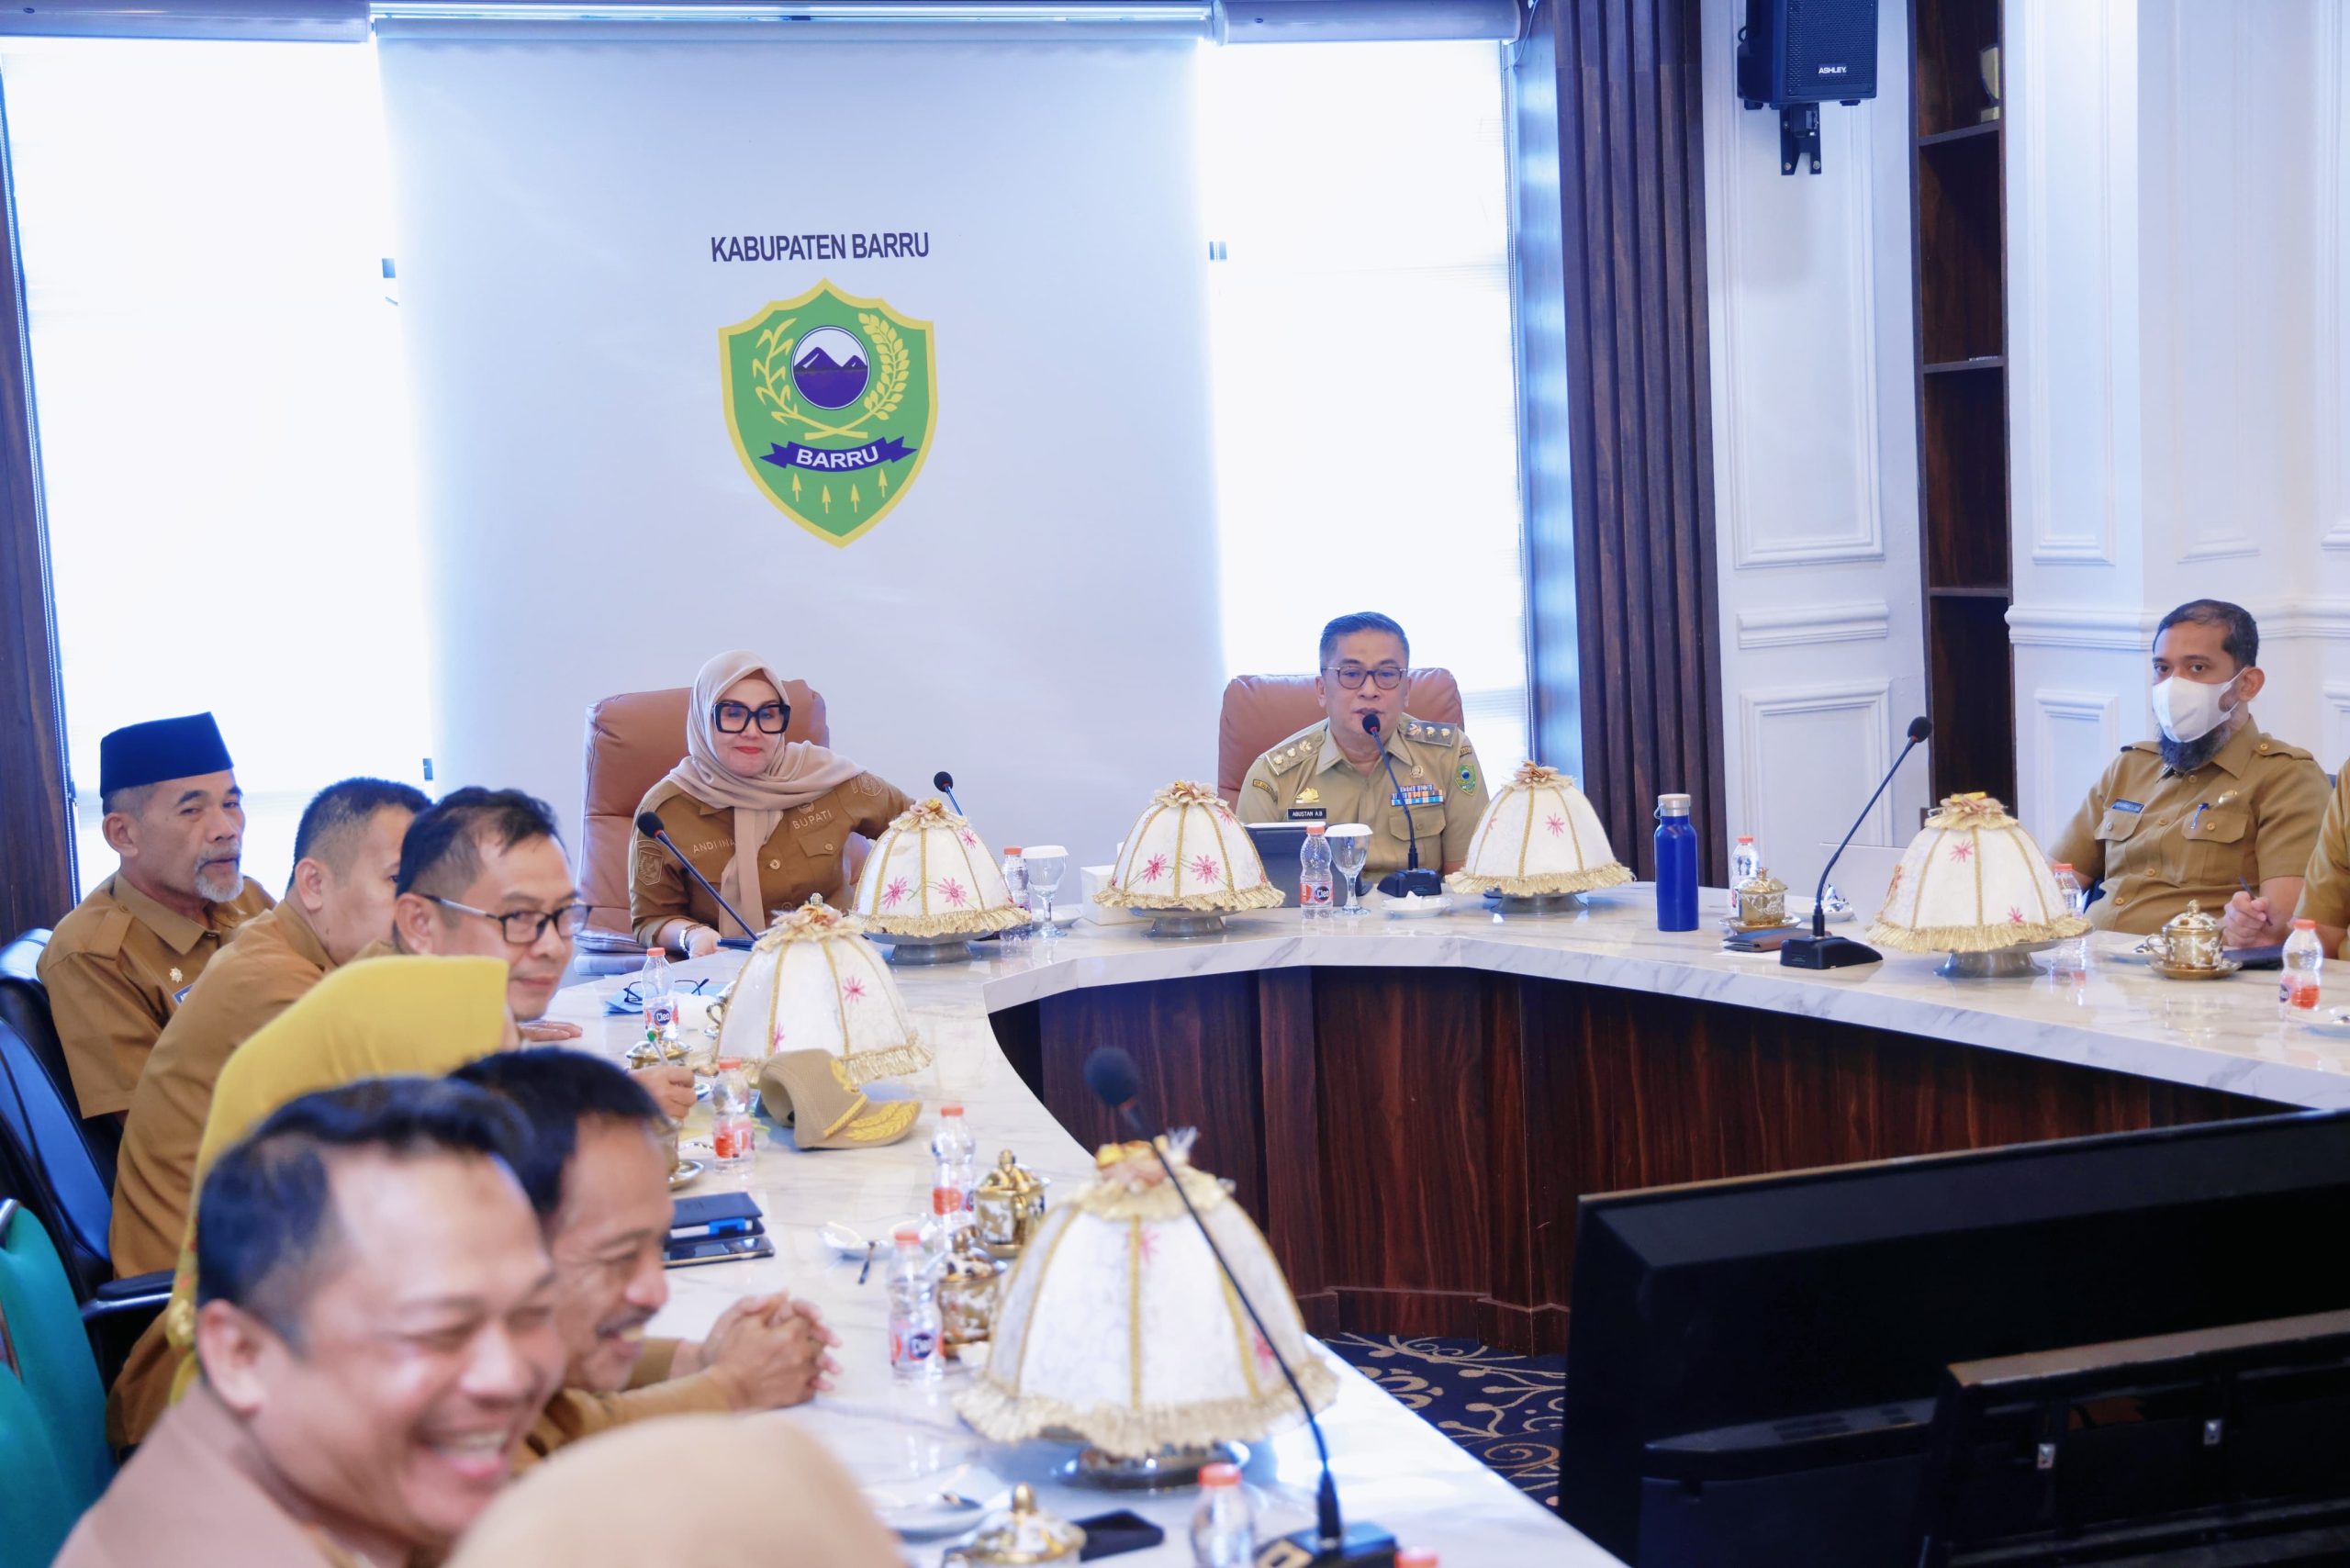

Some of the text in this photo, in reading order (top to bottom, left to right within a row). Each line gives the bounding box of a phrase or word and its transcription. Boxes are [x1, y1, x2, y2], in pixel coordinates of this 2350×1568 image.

[1818, 66, 1847, 74] ASHLEY
[711, 232, 930, 263] KABUPATEN BARRU
[796, 445, 879, 468] BARRU
[792, 809, 832, 829] BUPATI
[693, 841, 718, 854] ANDI
[656, 1012, 670, 1022] Cleo
